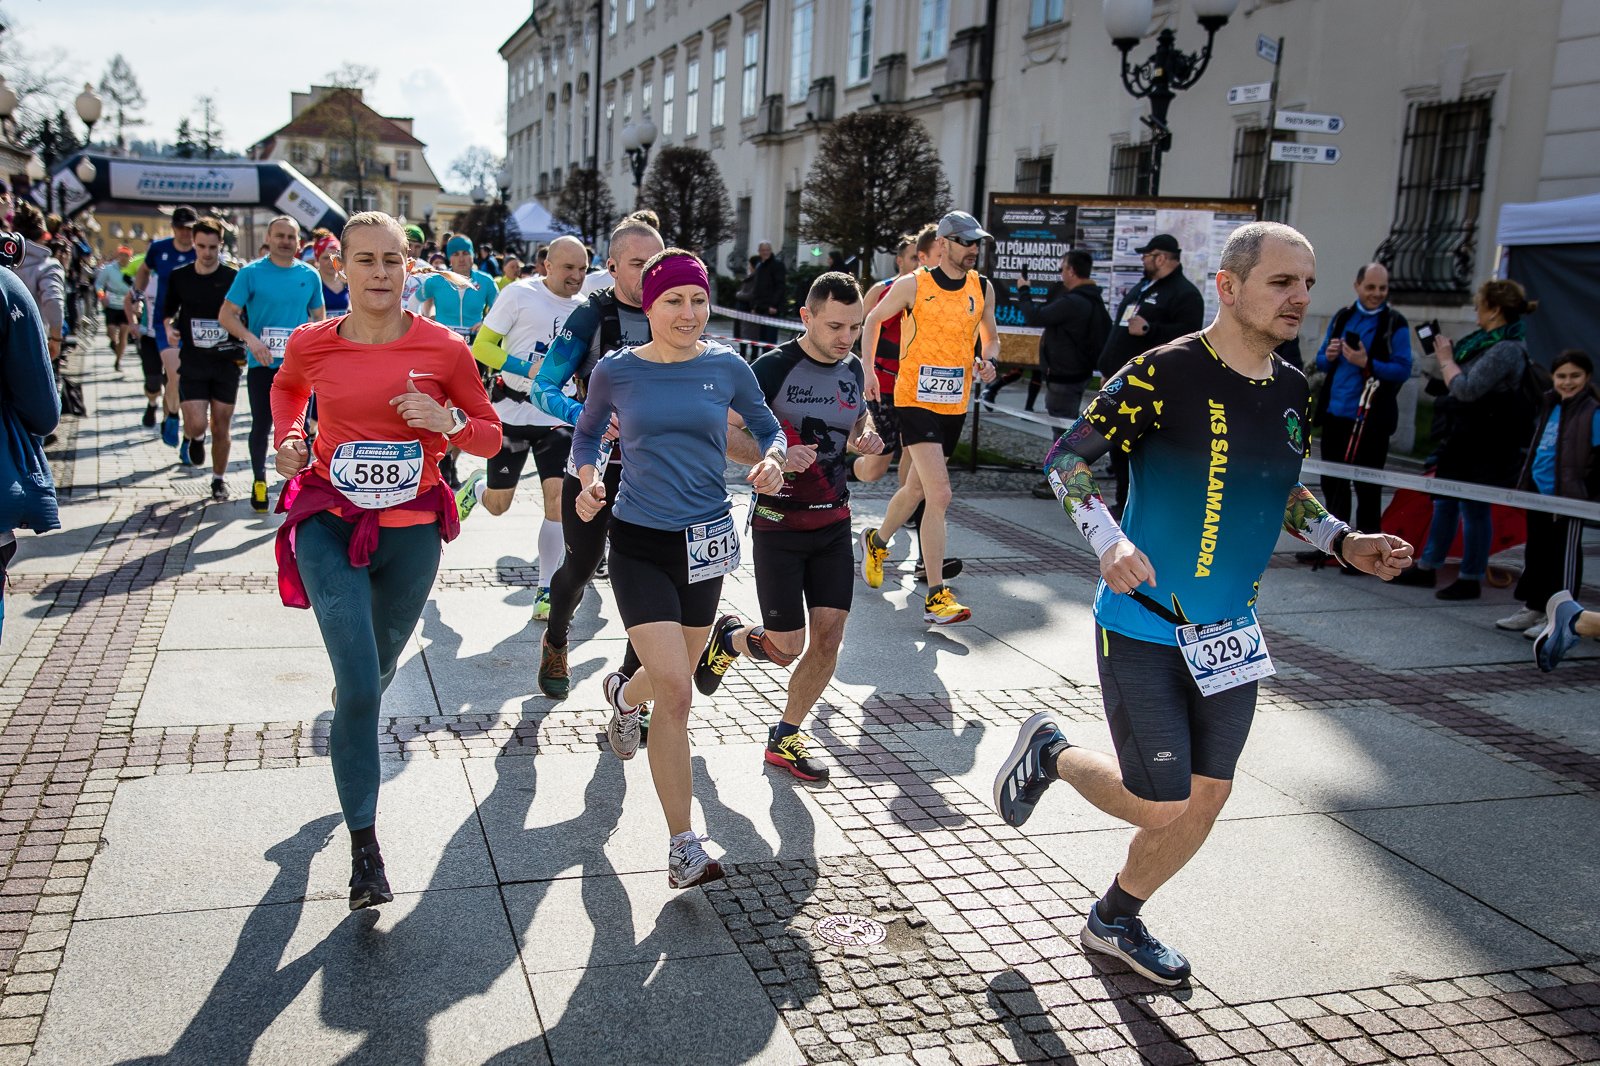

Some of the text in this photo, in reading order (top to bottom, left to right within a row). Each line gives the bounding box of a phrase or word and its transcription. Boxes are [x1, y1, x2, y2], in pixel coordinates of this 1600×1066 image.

[995, 241, 1005, 255] XI
[201, 329, 220, 338] 209
[786, 385, 814, 397] Mad
[930, 378, 954, 391] 278
[1208, 399, 1228, 435] JKS
[354, 463, 400, 485] 588
[1194, 438, 1229, 577] SALAMANDRA
[707, 531, 737, 558] 613
[1202, 635, 1242, 666] 329
